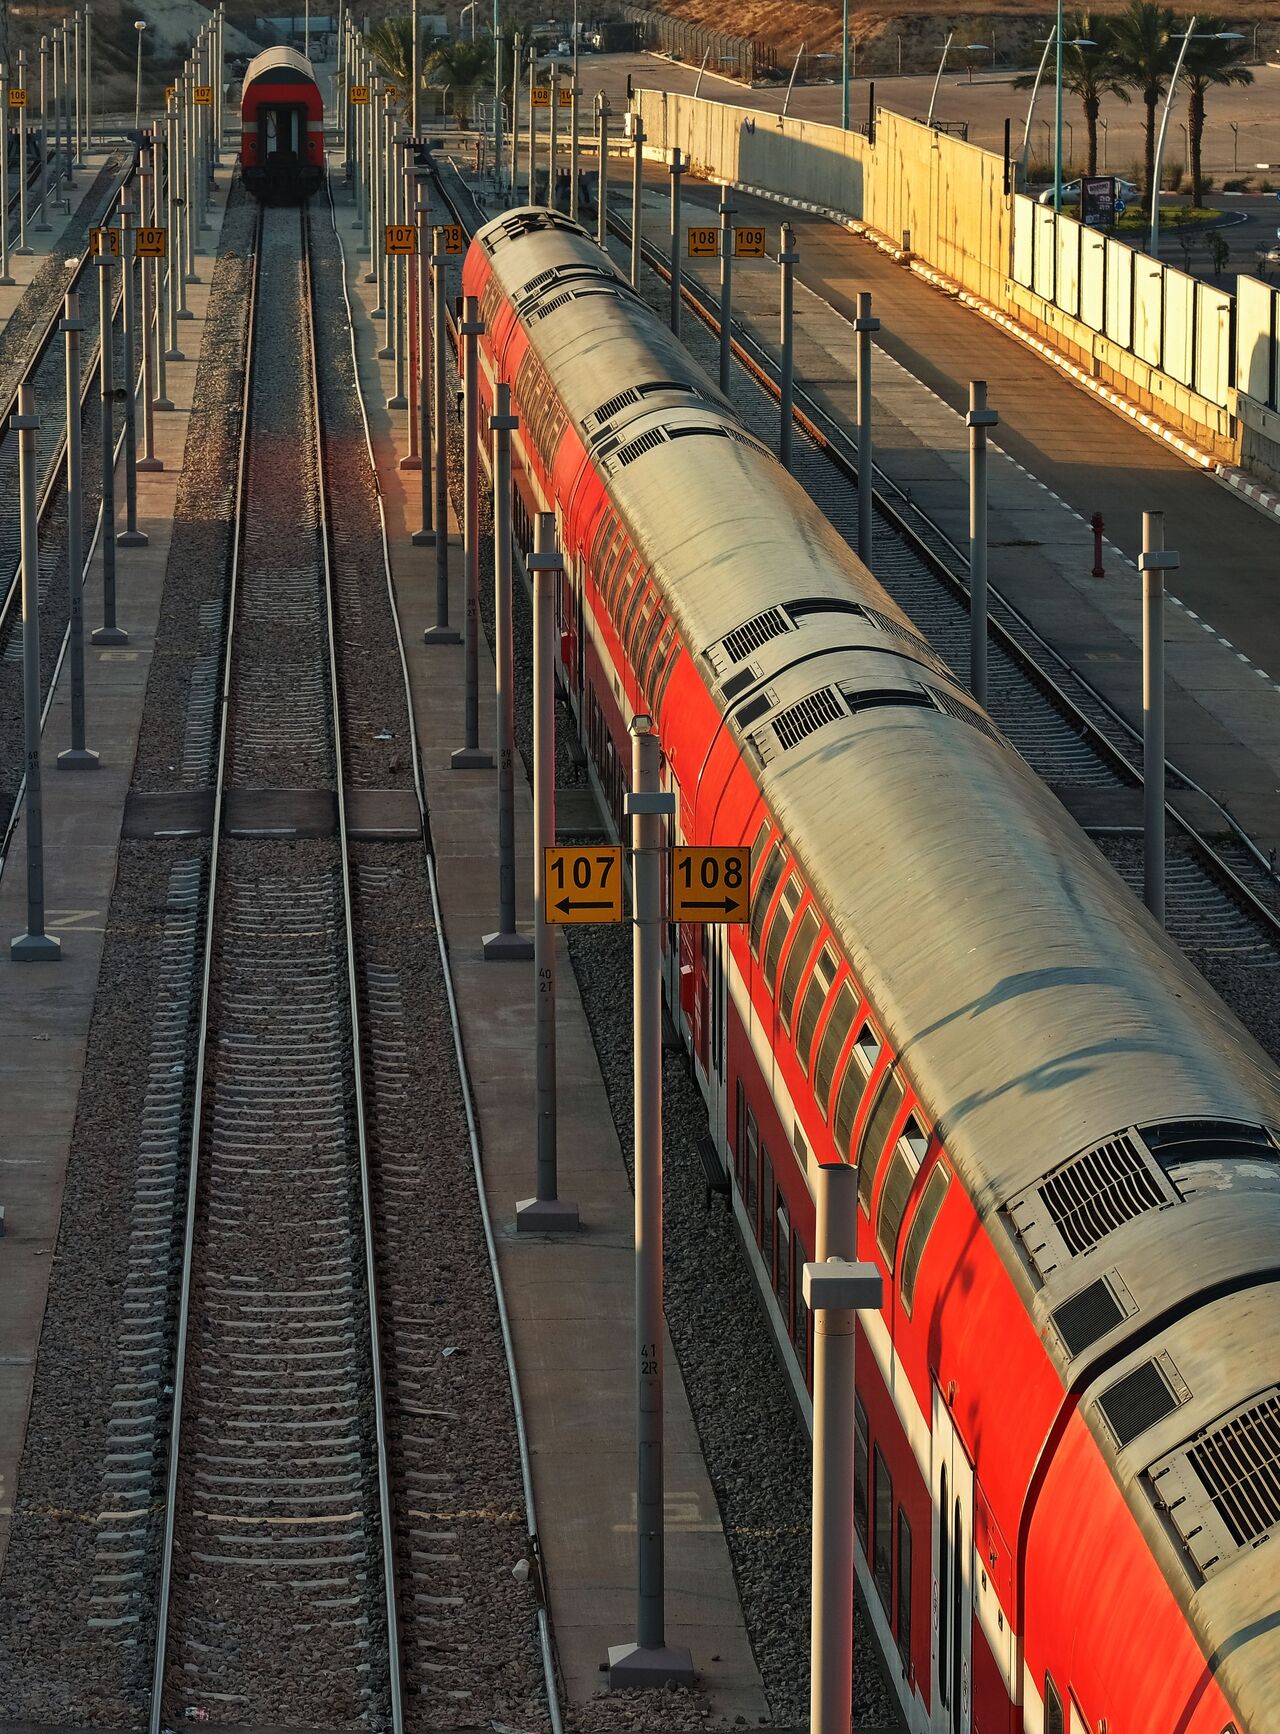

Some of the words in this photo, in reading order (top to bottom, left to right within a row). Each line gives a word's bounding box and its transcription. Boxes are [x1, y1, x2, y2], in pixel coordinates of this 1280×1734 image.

[10, 91, 25, 99] 106
[195, 89, 210, 97] 107
[352, 88, 366, 96] 107
[533, 91, 547, 99] 108
[562, 91, 571, 99] 10
[92, 232, 116, 244] 16
[139, 232, 163, 244] 107
[388, 229, 412, 242] 107
[691, 232, 715, 244] 108
[738, 232, 762, 244] 109
[551, 857, 614, 888] 107
[679, 857, 743, 888] 108
[539, 967, 551, 979] 40
[540, 981, 553, 992] 2T
[641, 1343, 656, 1358] 41
[641, 1361, 658, 1374] 2R
